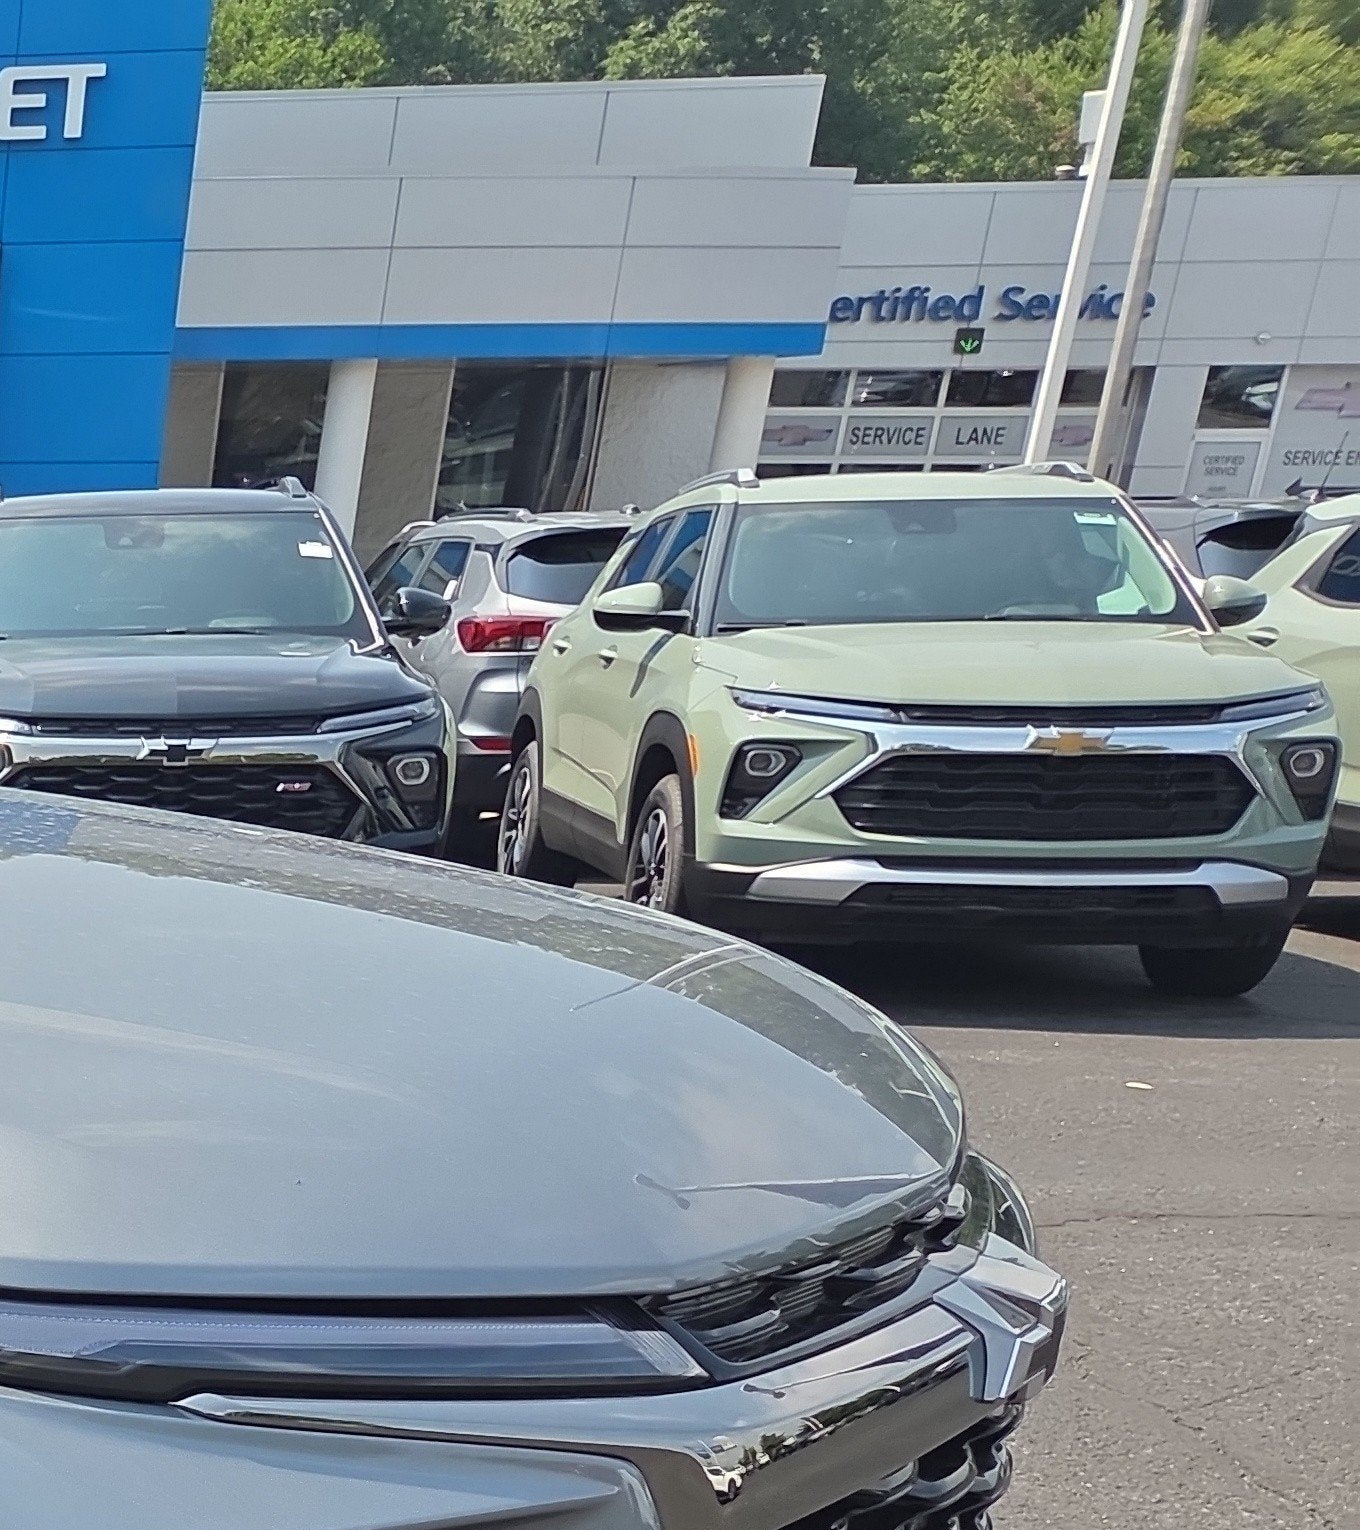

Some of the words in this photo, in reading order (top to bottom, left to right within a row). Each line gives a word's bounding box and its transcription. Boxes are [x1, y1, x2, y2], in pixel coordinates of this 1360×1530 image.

[829, 285, 985, 323] ertified
[849, 426, 927, 446] SERVICE
[955, 426, 1007, 446] LANE
[1282, 450, 1344, 466] SERVICE
